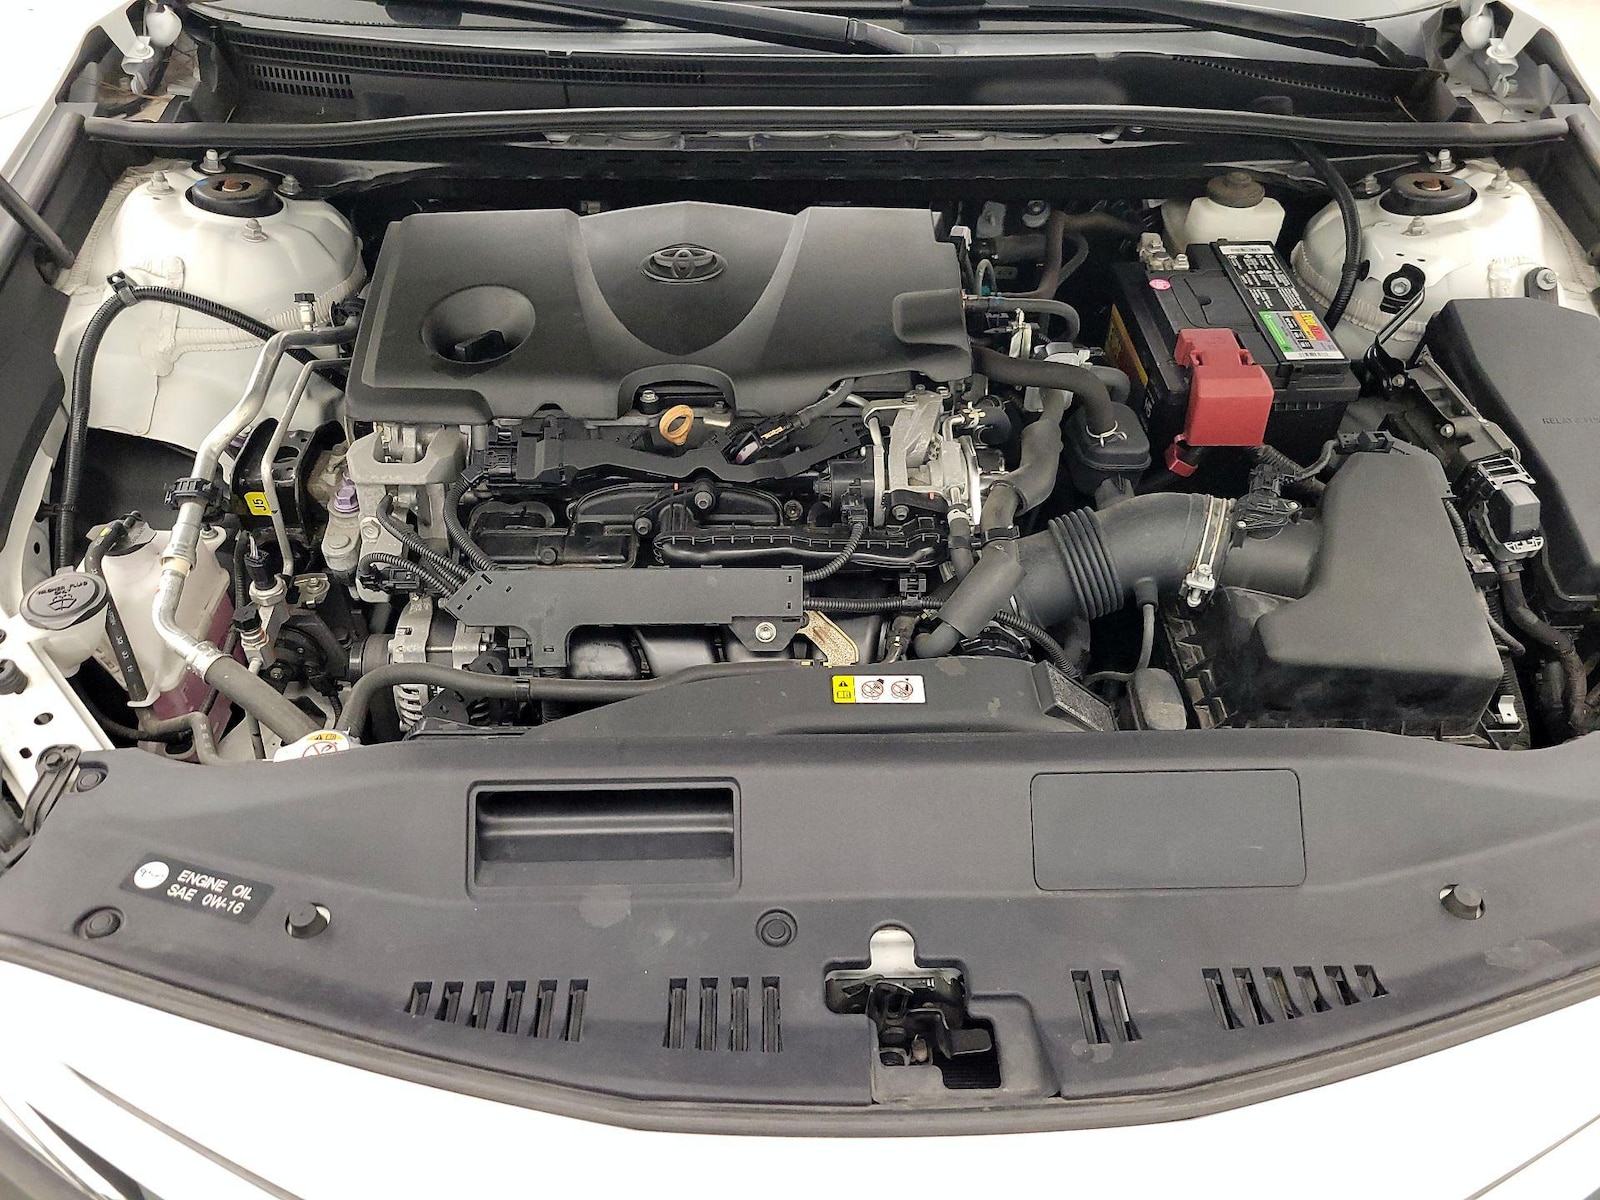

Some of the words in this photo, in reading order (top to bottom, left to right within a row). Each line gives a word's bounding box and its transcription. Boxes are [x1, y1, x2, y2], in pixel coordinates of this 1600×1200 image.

[252, 498, 267, 511] J5
[167, 884, 198, 901] SAE
[202, 893, 245, 914] 0W-16
[177, 870, 228, 893] ENGINE
[232, 885, 252, 900] OIL
